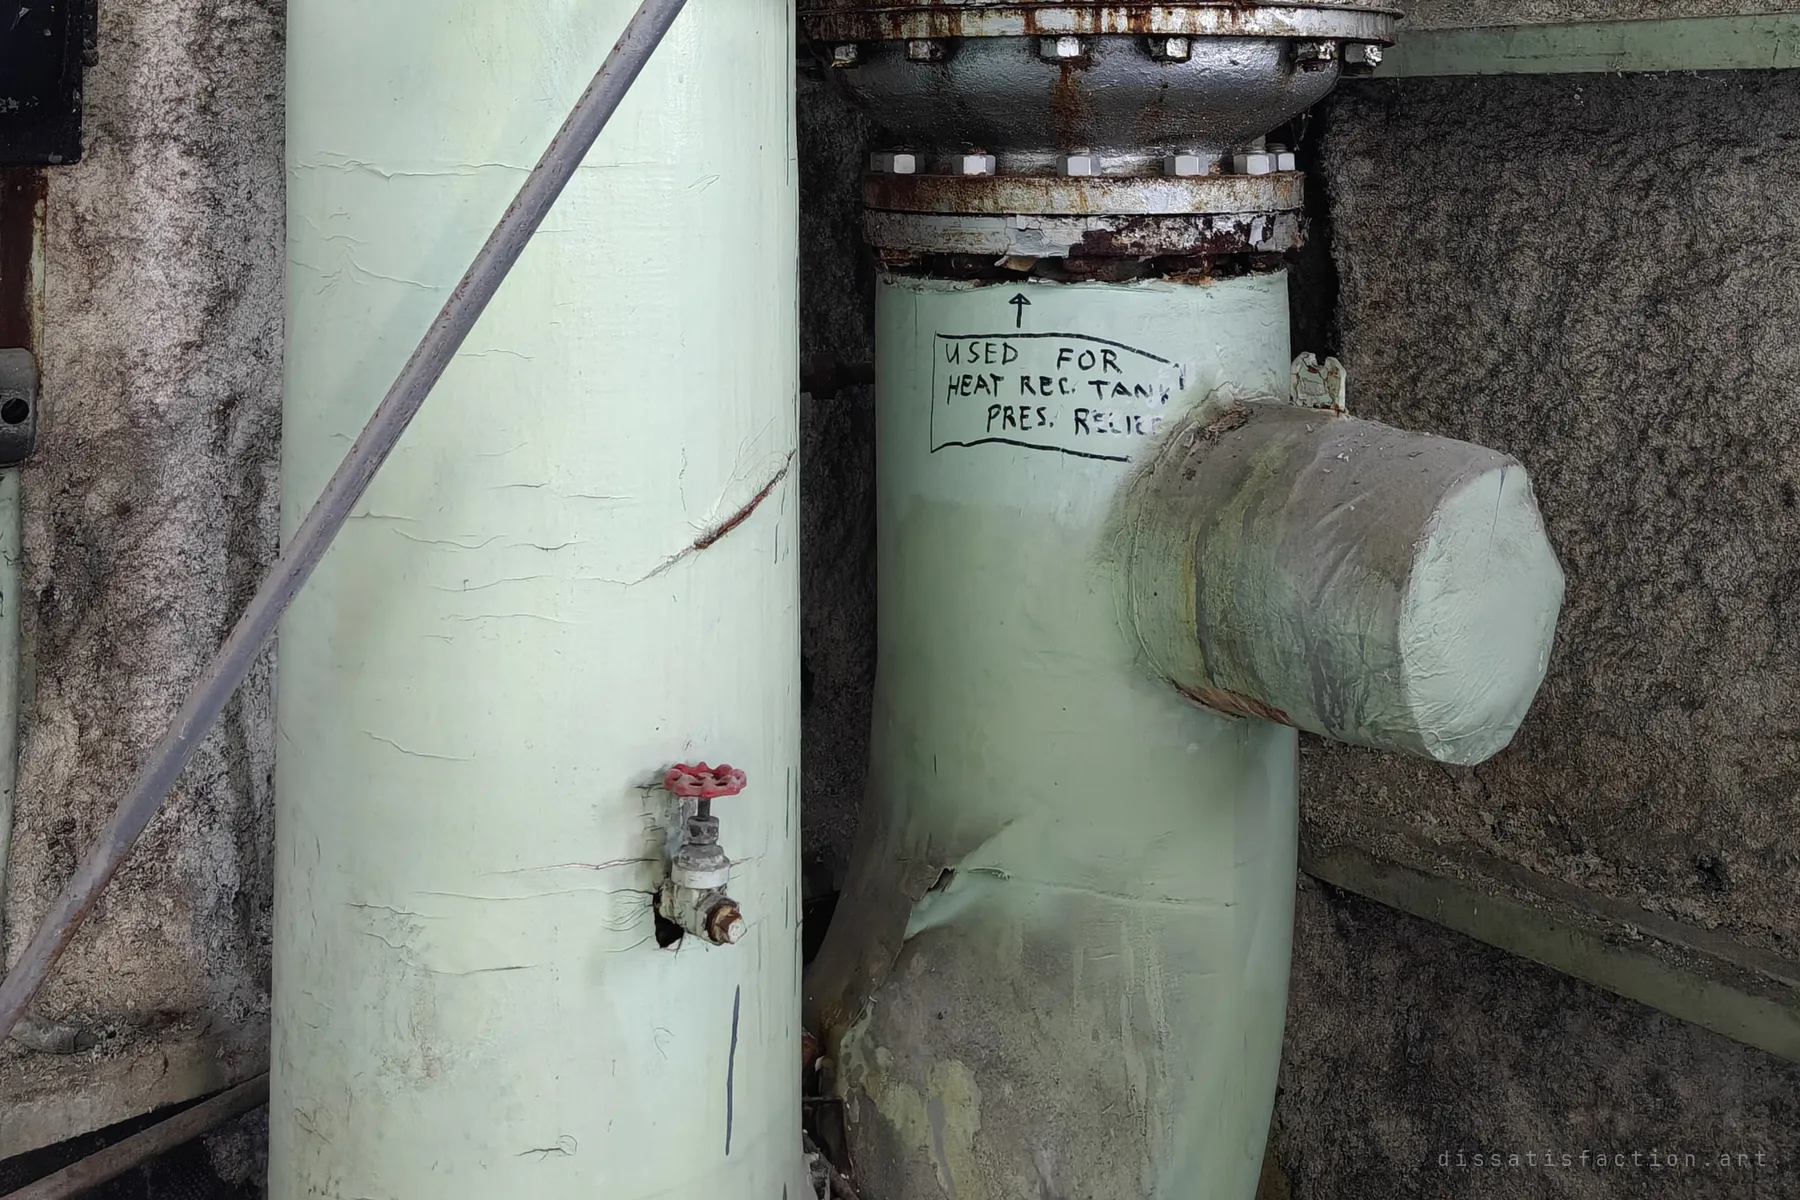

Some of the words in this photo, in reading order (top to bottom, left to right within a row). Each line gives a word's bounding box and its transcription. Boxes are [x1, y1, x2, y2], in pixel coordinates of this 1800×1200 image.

[945, 341, 1019, 366] USED
[1056, 348, 1123, 374] FOR
[947, 372, 1004, 405] HEAT
